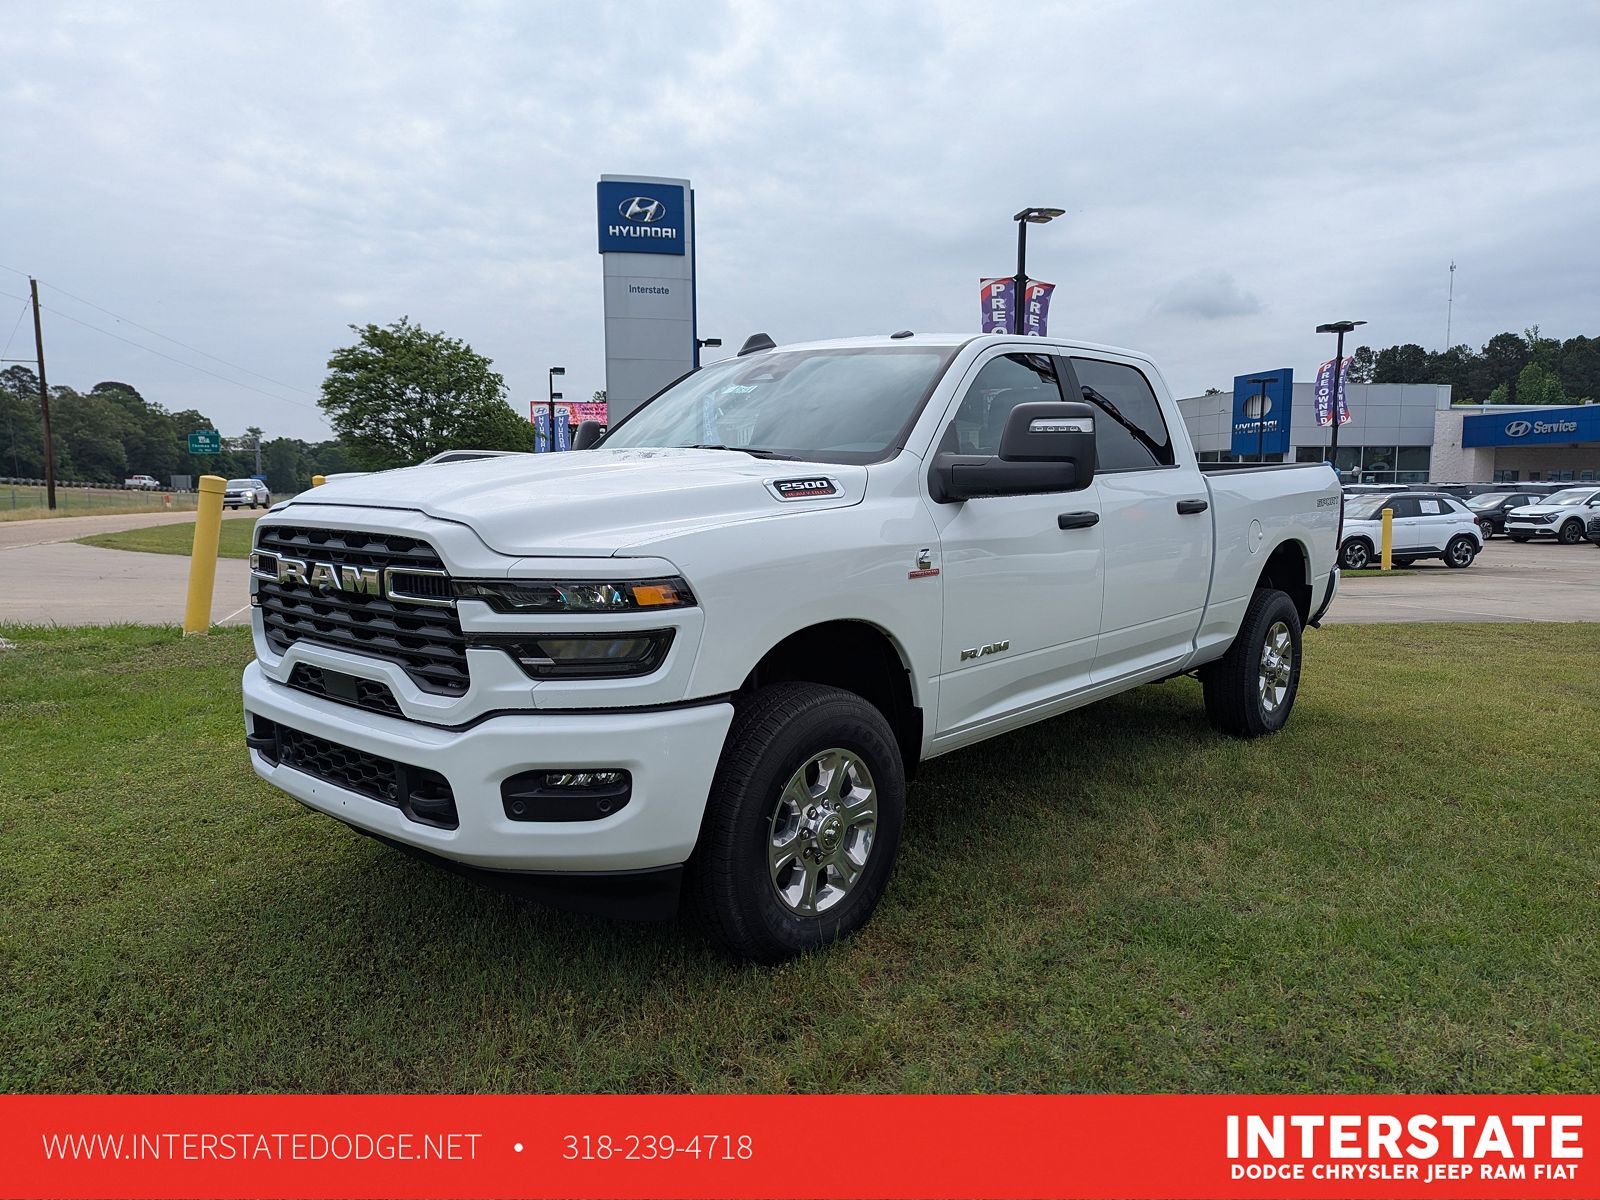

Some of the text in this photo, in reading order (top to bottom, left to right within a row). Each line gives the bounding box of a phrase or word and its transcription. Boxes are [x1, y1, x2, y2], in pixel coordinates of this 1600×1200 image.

[609, 225, 677, 239] HYUNDAI
[629, 284, 670, 295] Interstate
[1318, 363, 1332, 424] PREOWNED
[1533, 419, 1577, 434] Service
[779, 480, 829, 492] 2500
[278, 557, 380, 598] RAM
[960, 640, 1010, 661] RAM
